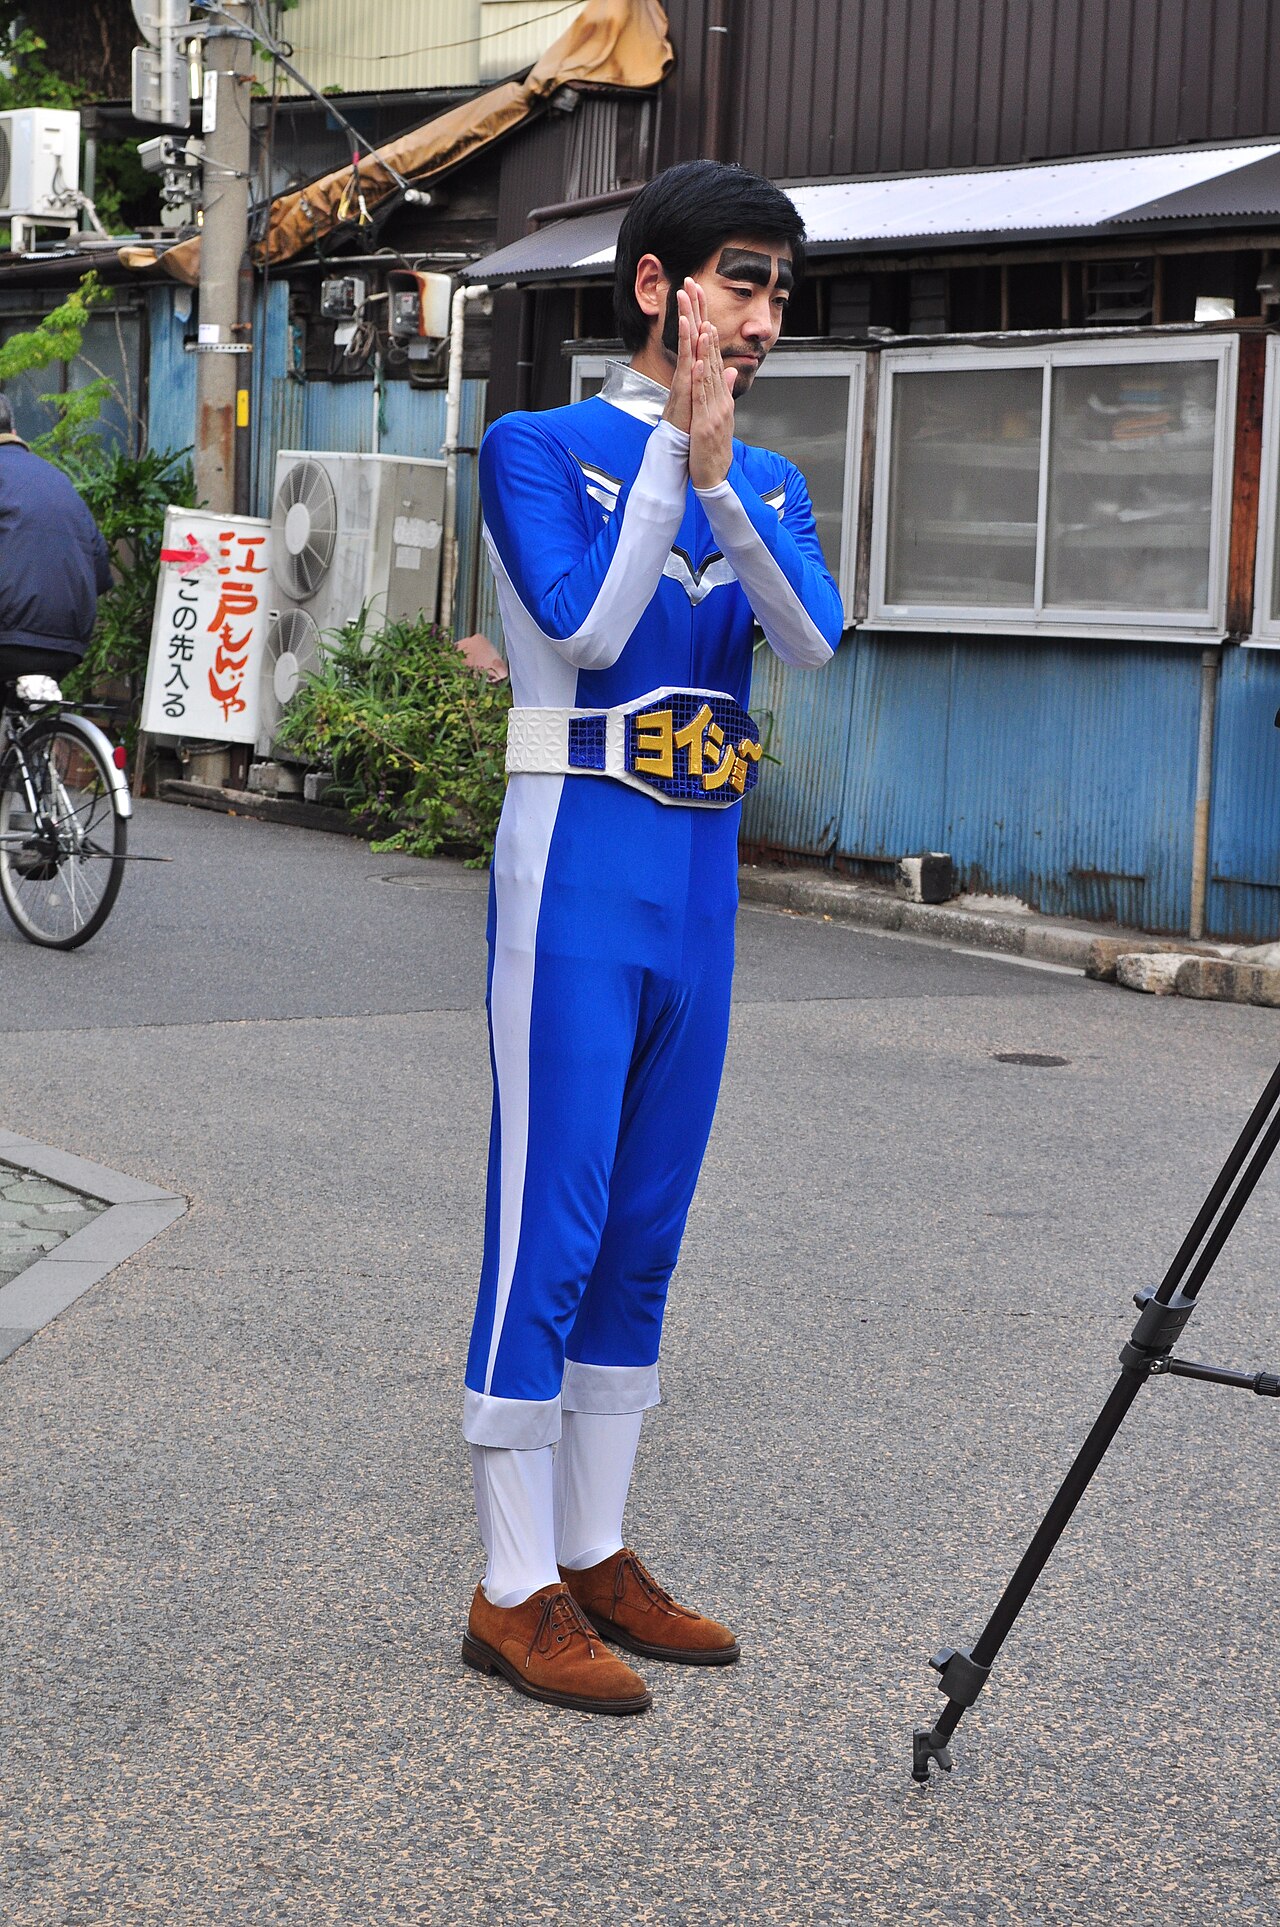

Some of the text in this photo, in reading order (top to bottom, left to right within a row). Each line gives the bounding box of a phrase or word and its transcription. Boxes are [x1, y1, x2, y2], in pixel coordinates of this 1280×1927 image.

[162, 578, 199, 718] この先入る
[207, 531, 268, 722] 江戸もんじゃ
